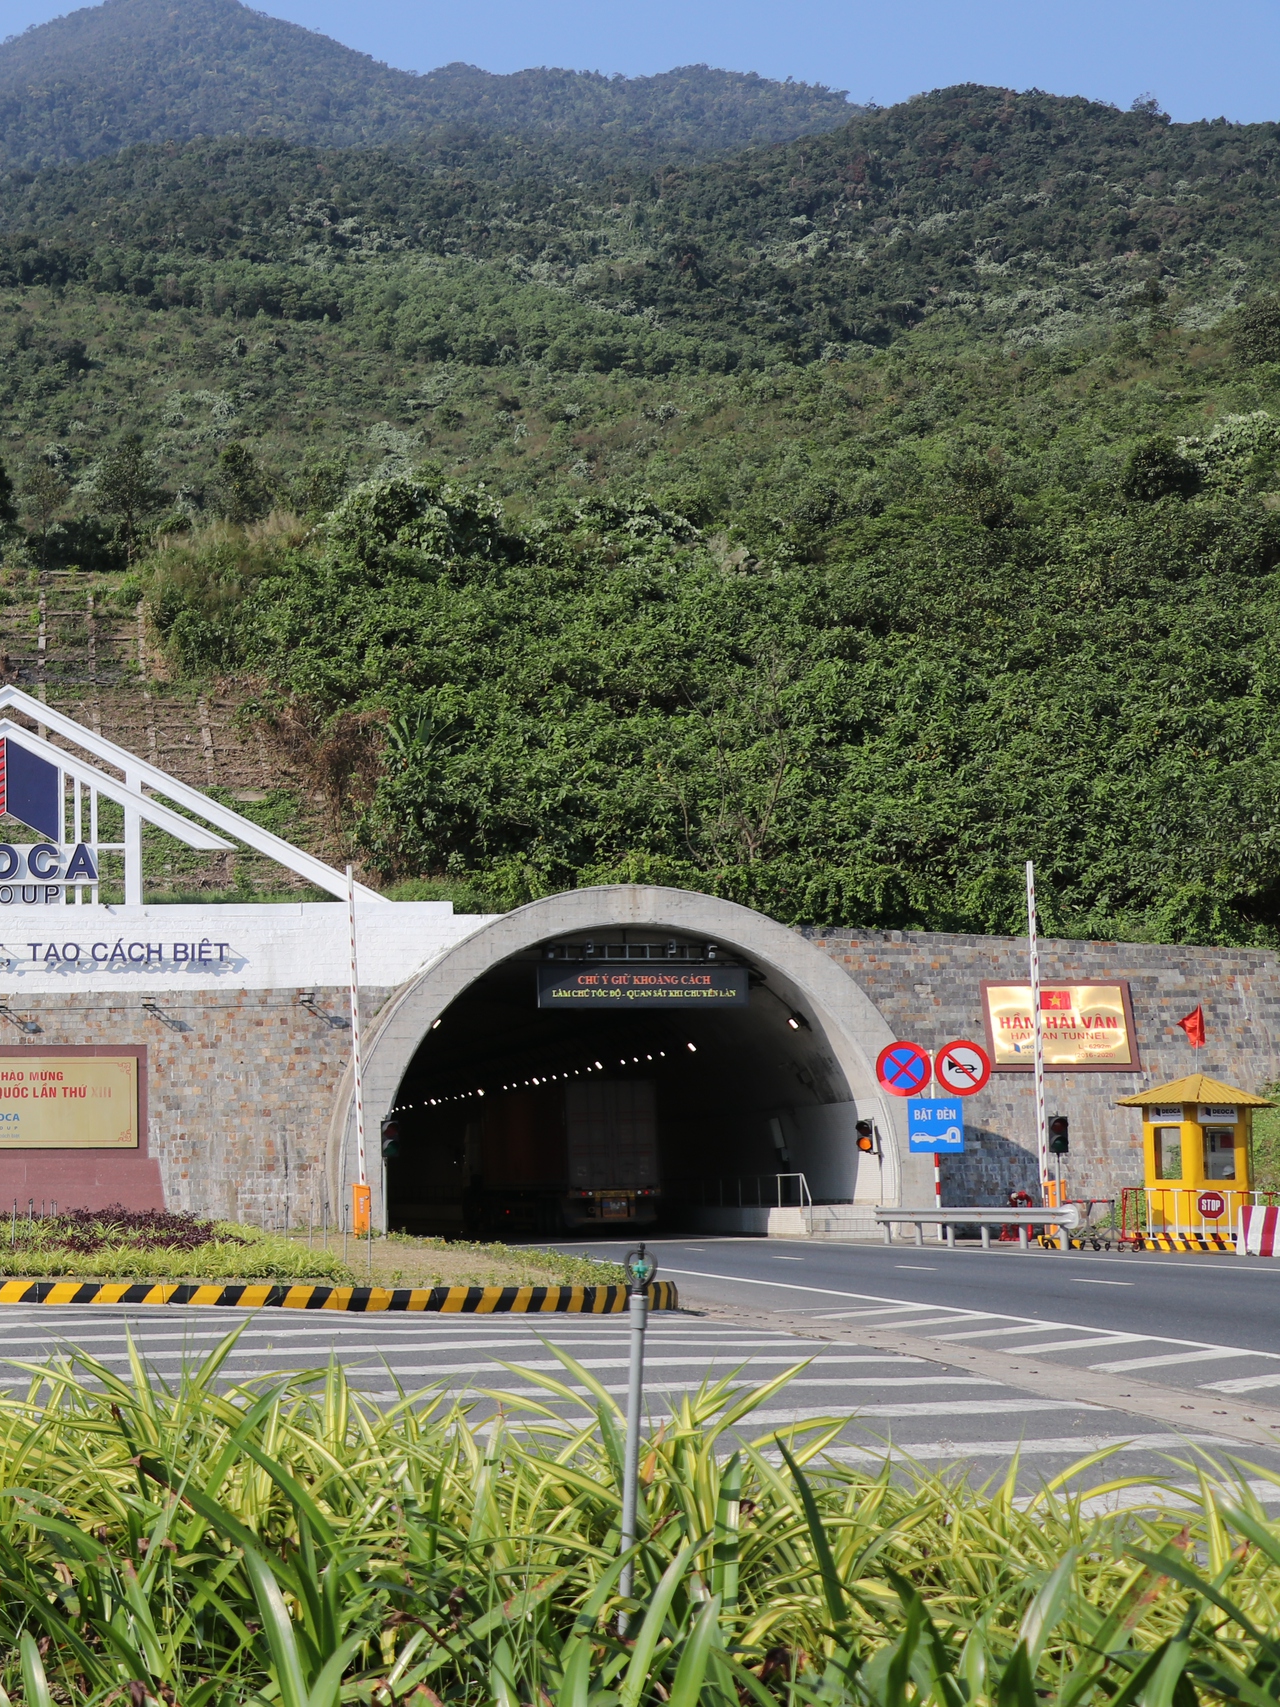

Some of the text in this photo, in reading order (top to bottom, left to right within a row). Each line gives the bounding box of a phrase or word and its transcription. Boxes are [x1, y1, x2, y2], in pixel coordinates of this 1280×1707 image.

[27, 942, 81, 966] TẠO
[91, 938, 163, 962] CÁCH
[173, 938, 230, 966] BIỆT
[681, 973, 711, 985] CÁCH
[627, 989, 652, 999] QUAN
[1046, 1012, 1077, 1029] HẢI
[1081, 1013, 1118, 1029] VÂN
[1010, 1032, 1109, 1040] HAI AN TUNNEL
[29, 1069, 64, 1081] MỪNG
[33, 1083, 57, 1099] LẦN
[62, 1084, 88, 1099] THỨ
[91, 1086, 113, 1099] XIII
[913, 1106, 957, 1122] BẬT ĐÈN
[1201, 1199, 1221, 1211] STOP
